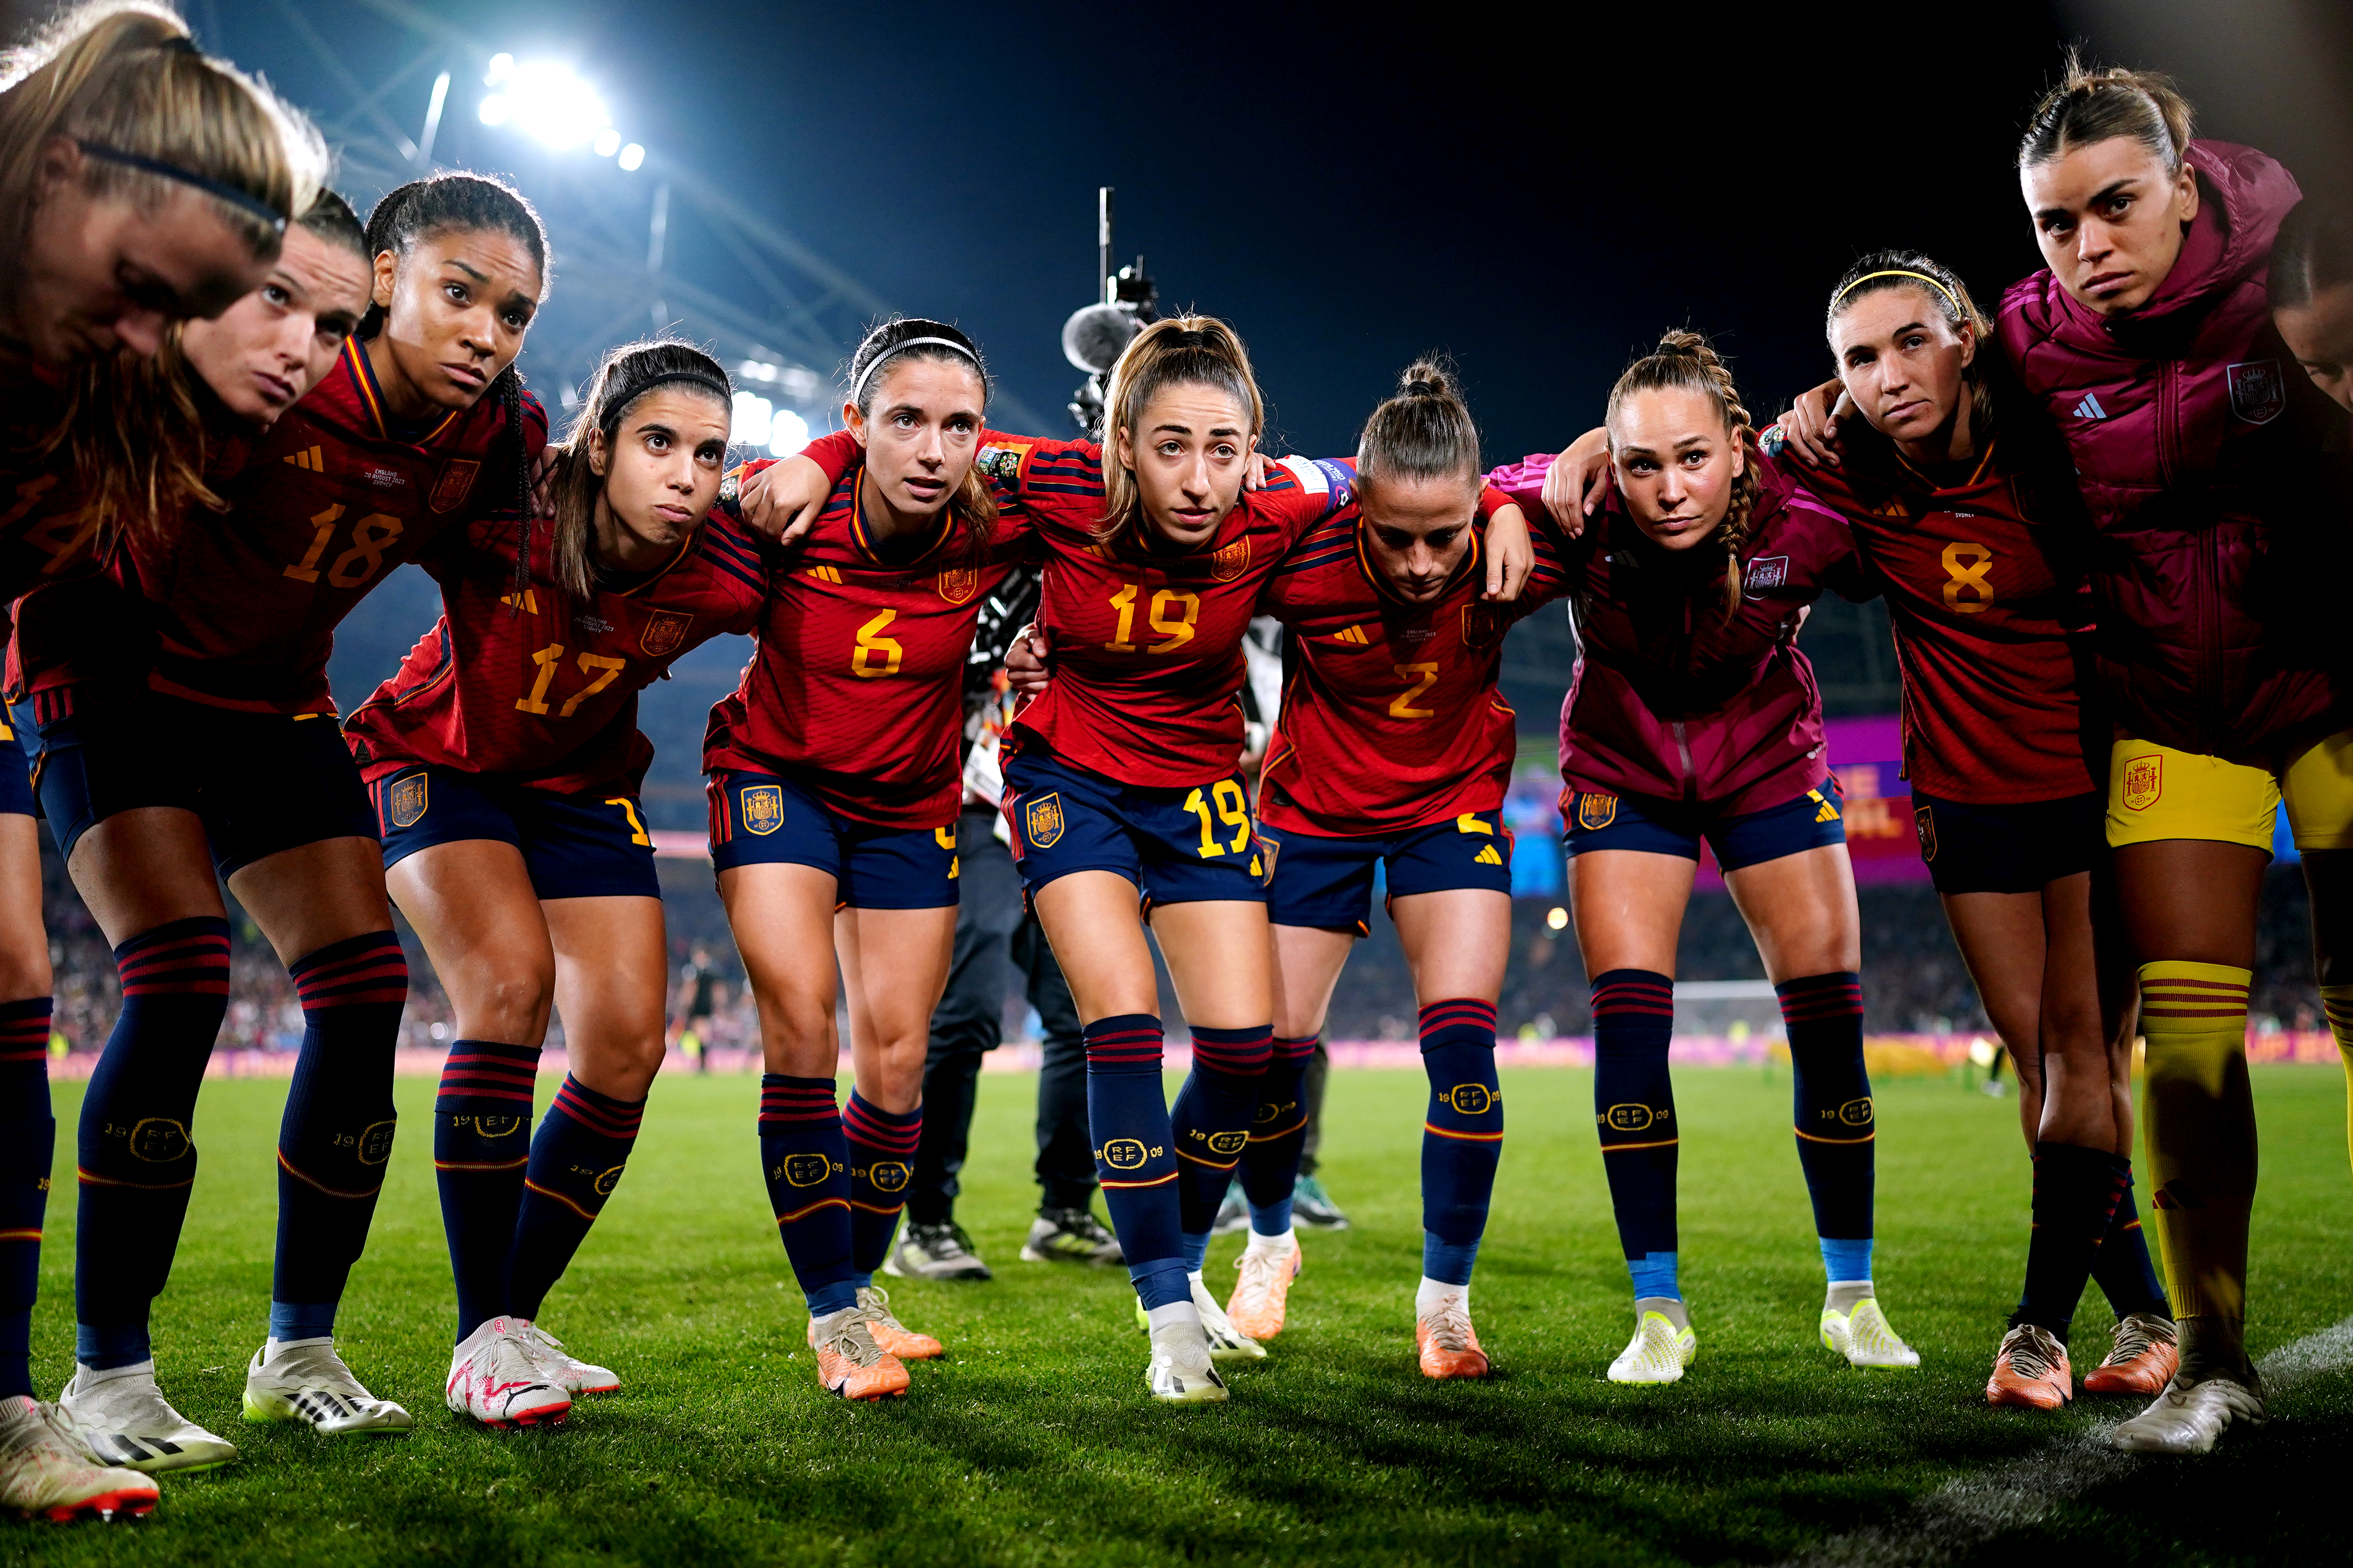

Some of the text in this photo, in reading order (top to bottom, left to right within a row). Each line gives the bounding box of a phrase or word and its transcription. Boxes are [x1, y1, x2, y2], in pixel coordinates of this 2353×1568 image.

[372, 473, 391, 482] AUGUST
[374, 468, 397, 478] ENGLAND
[373, 479, 393, 488] SYDNEY
[282, 503, 404, 588] 18
[1942, 541, 1994, 613] 8
[582, 619, 601, 628] AUGUST
[584, 615, 607, 625] ENGLAND
[1105, 583, 1201, 655] 19
[583, 624, 602, 633] SYDNEY
[851, 608, 903, 678] 6
[515, 643, 626, 717] 17
[1389, 662, 1438, 718] 2
[1182, 779, 1251, 858] 19
[1439, 1092, 1450, 1103] 19
[1656, 1109, 1668, 1120] 09
[105, 1123, 126, 1138] 19
[1189, 1129, 1206, 1141] 19
[334, 1133, 355, 1147] 19
[1150, 1146, 1163, 1158] 09
[833, 1163, 843, 1172] 09
